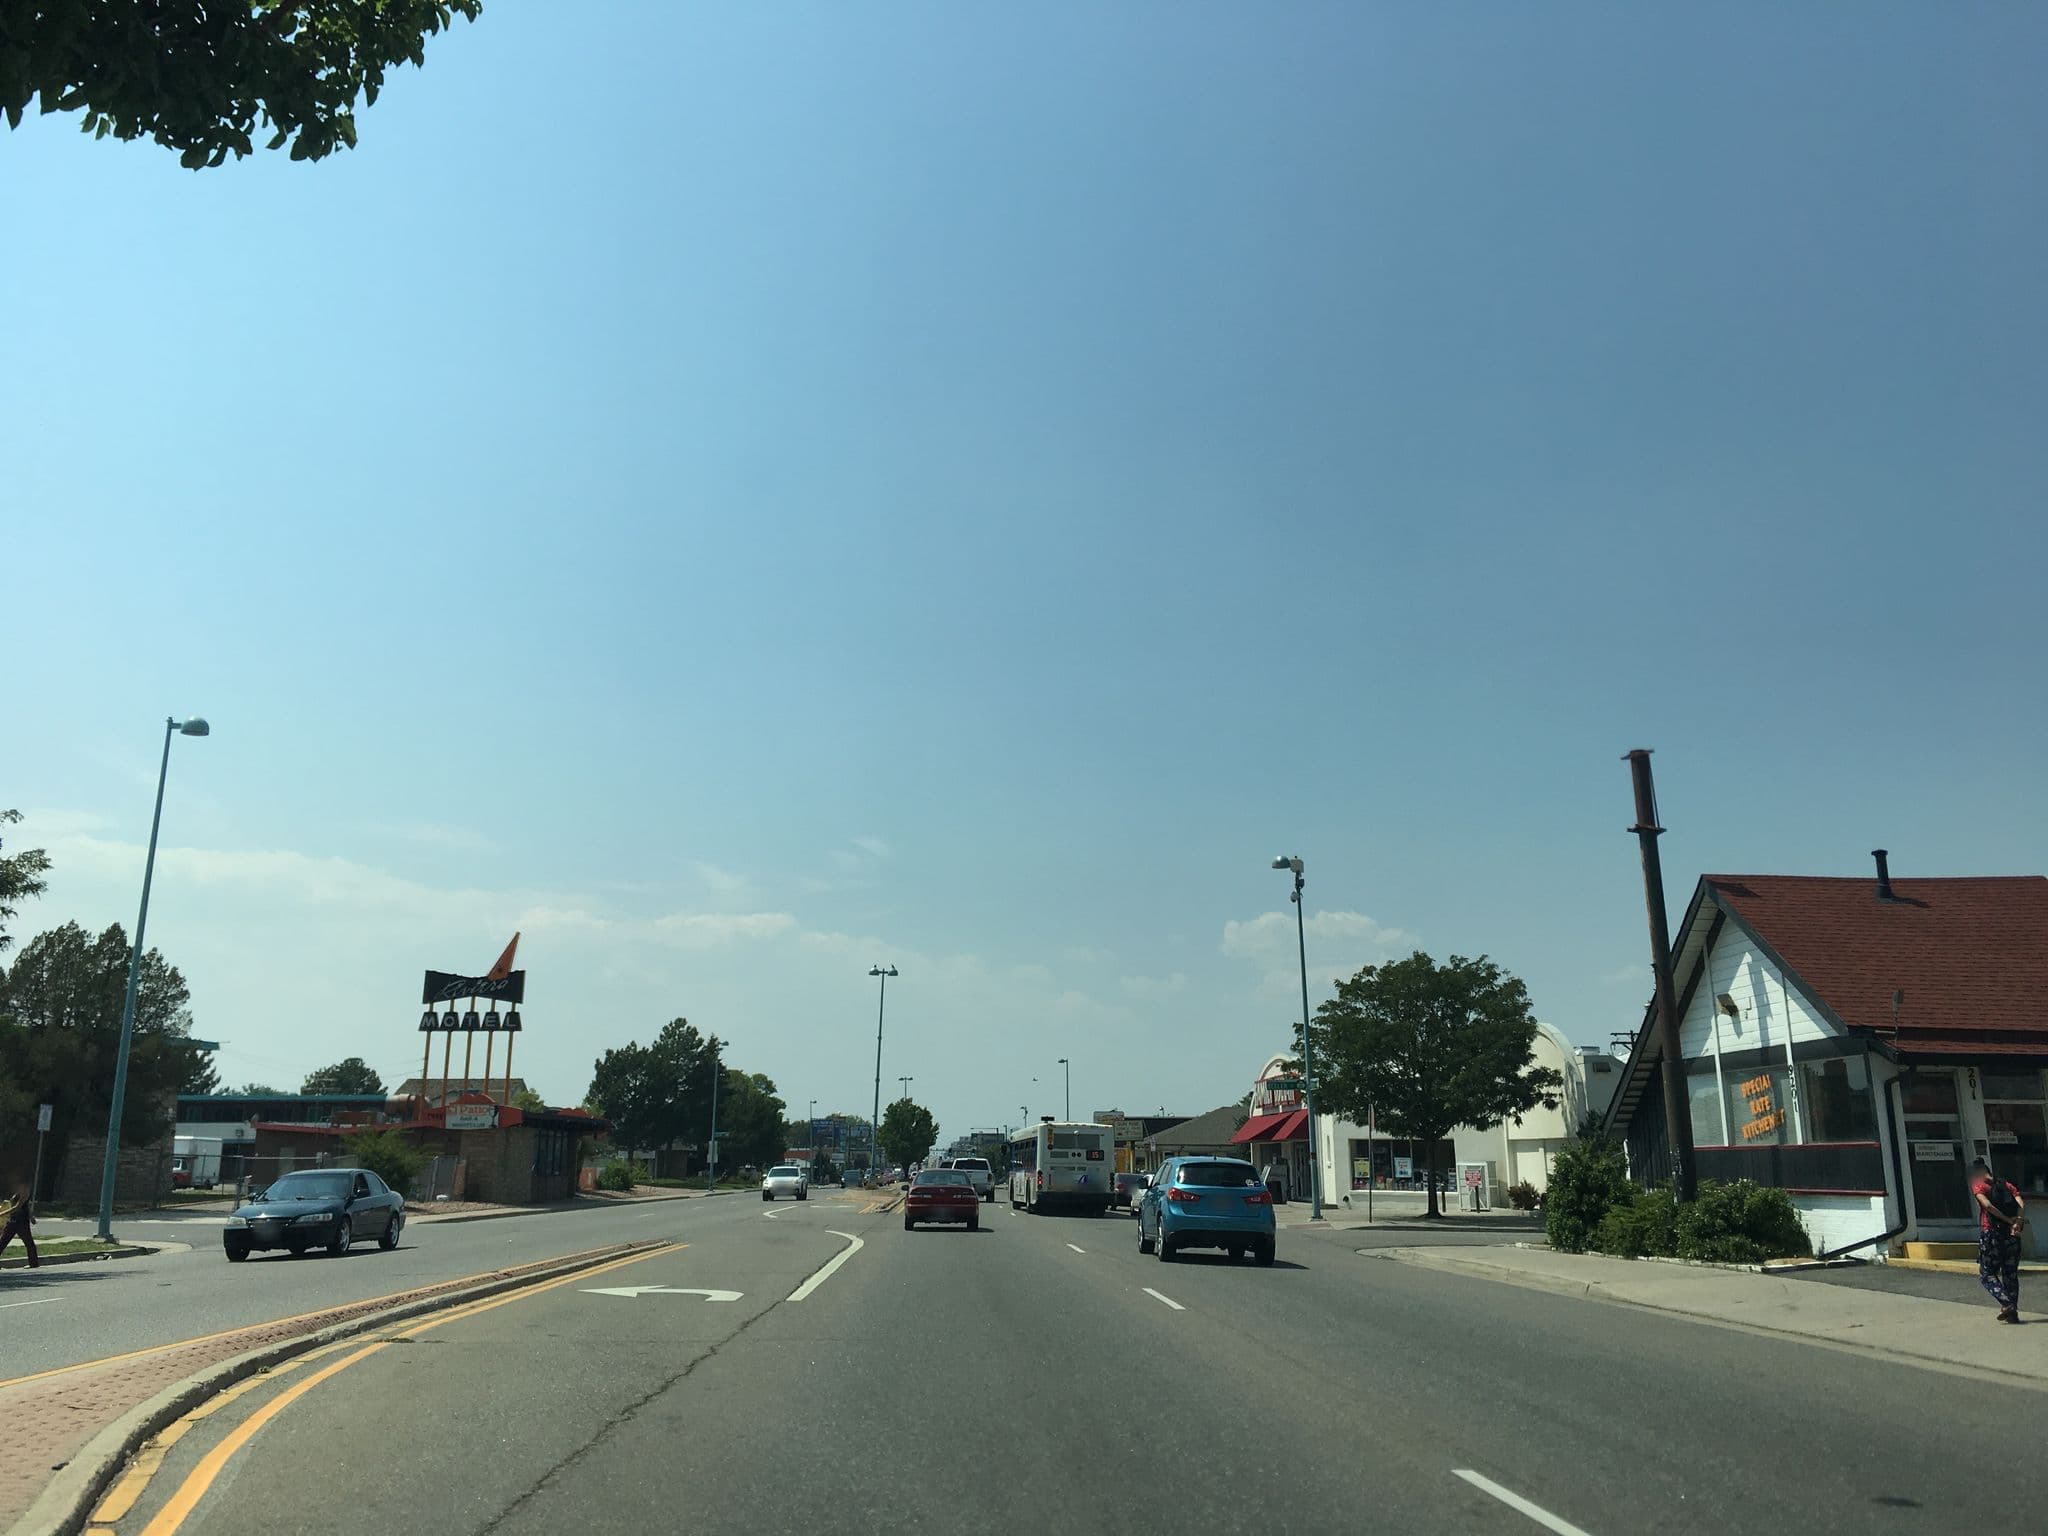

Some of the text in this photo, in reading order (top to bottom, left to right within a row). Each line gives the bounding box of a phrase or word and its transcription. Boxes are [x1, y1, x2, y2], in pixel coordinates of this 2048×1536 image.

[433, 979, 509, 1001] Riviera
[422, 1015, 516, 1027] MOTEL
[1788, 1064, 1798, 1113] 9201
[1967, 1068, 1977, 1100] 201
[1749, 1096, 1771, 1114] RATE
[1091, 1151, 1099, 1159] 15
